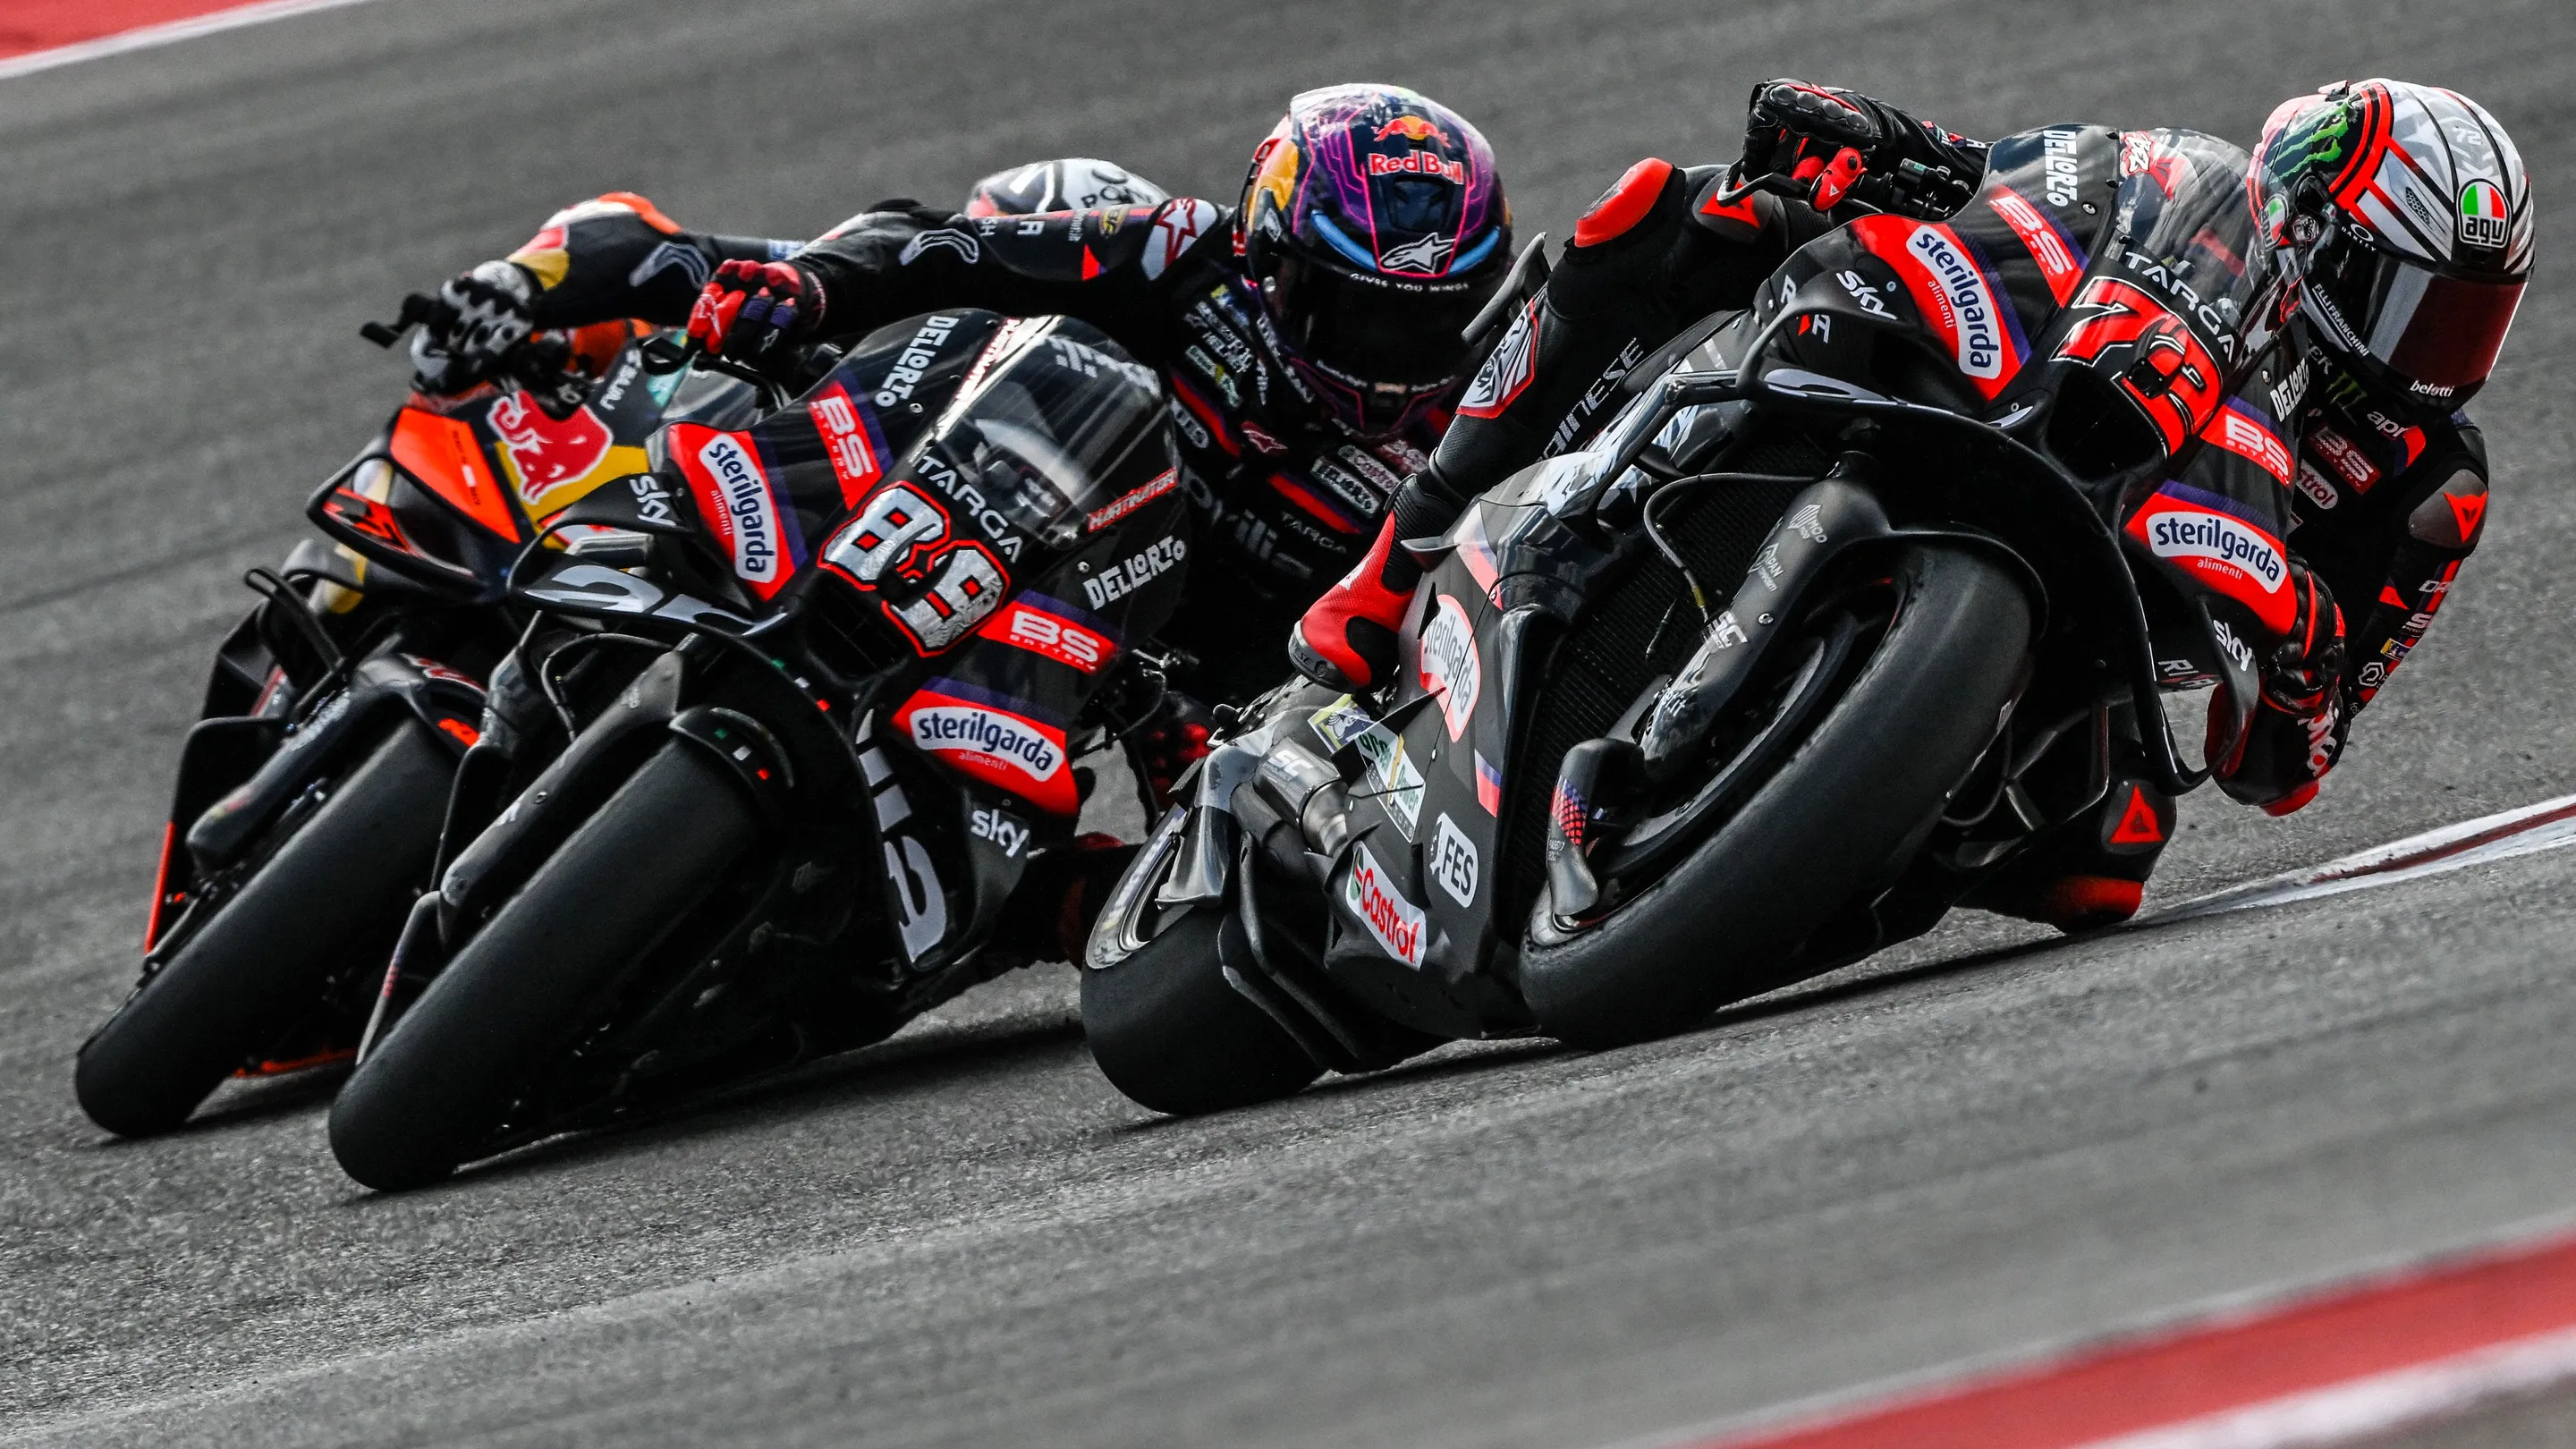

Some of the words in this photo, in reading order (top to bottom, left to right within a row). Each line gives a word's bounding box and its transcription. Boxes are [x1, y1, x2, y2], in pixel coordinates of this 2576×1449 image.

[1368, 149, 1420, 176] Red
[1420, 151, 1464, 185] Bull
[2043, 130, 2079, 208] DELLORTO
[1996, 195, 2073, 275] BS
[2341, 226, 2377, 252] OAKLEY
[2465, 216, 2504, 243] agv
[1350, 273, 1388, 288] GIVES
[1395, 282, 1423, 292] YOU
[1835, 270, 1898, 320] sky
[1916, 233, 1999, 369] sterilgarda
[1928, 280, 1956, 328] alimenti
[2126, 251, 2235, 363] TARGA
[2328, 305, 2370, 357] FRANCHINI
[875, 315, 960, 408] DELLORTO
[2269, 357, 2310, 422] DELLORTO
[2410, 380, 2455, 398] belotti
[1537, 337, 1644, 462] AINESE
[818, 395, 874, 478] BS
[2225, 414, 2290, 477] BS
[2313, 426, 2374, 482] BS
[629, 476, 677, 527] sky
[708, 442, 775, 572] sterilgarda
[711, 489, 733, 536] alimenti
[915, 455, 1027, 564] TARGA
[818, 480, 1011, 658] 89
[1082, 535, 1187, 611] DELLORTO
[2155, 517, 2281, 582] sterilgarda
[2198, 558, 2244, 580] alimenti
[1011, 610, 1099, 662] BS
[1424, 614, 1474, 714] sterilgada
[2213, 619, 2252, 672] sky
[918, 712, 1054, 771] sterilgarda
[959, 750, 1007, 771] alimenti
[1267, 749, 1314, 776] SC
[970, 809, 1030, 858] sky
[1442, 835, 1474, 896] FES
[1361, 868, 1420, 964] Castrol
